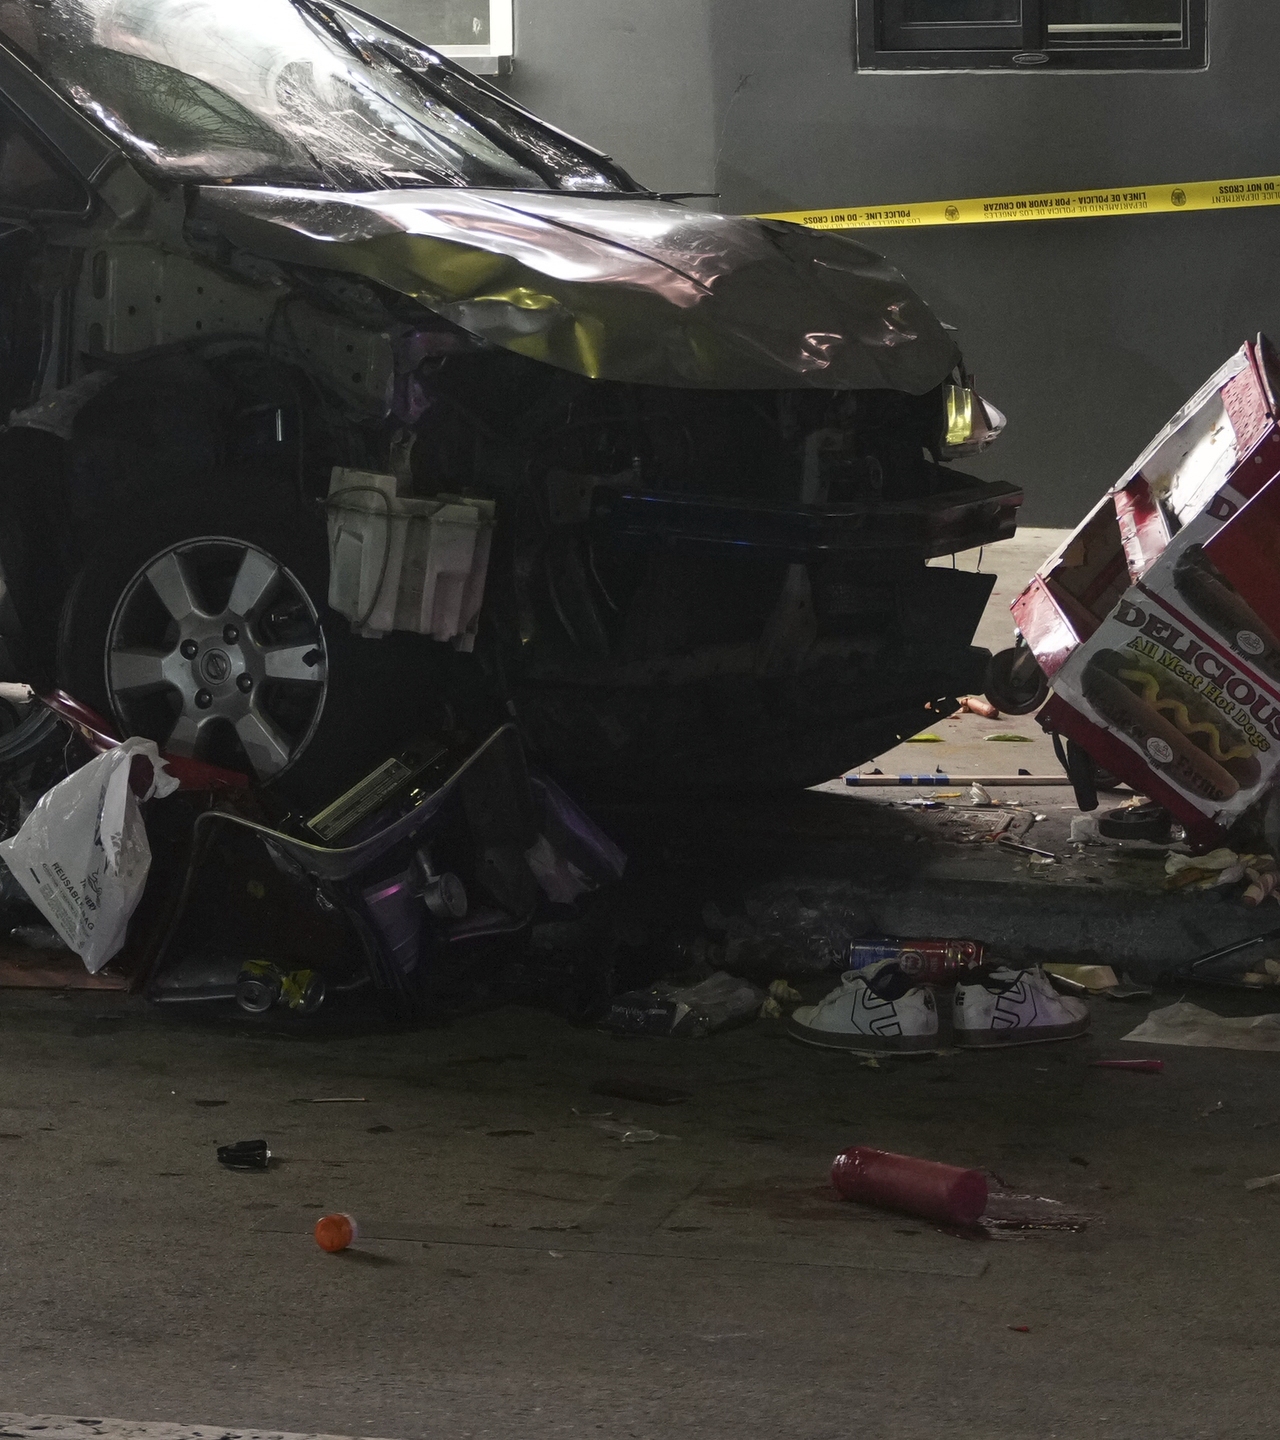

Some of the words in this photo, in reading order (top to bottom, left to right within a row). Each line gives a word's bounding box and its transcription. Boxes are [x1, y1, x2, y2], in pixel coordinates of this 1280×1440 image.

[1219, 185, 1244, 194] CROSS
[1246, 183, 1262, 192] NOT
[1264, 182, 1274, 191] DO
[1079, 195, 1109, 204] POLICIA
[1111, 194, 1121, 202] DE
[1123, 192, 1146, 201] LINEA
[1212, 192, 1260, 204] DEPARTMENT
[983, 201, 1014, 211] CRUZAR
[1016, 200, 1027, 209] NO
[1029, 199, 1053, 208] FAVOR
[1055, 198, 1070, 206] POR
[1090, 201, 1147, 212] DEPARTAMENTO
[1019, 208, 1034, 217] LOS
[1036, 208, 1045, 216] DE
[1046, 206, 1076, 215] POLICIA
[1078, 205, 1088, 213] DE
[830, 214, 845, 223] NOT
[847, 213, 857, 222] DO
[865, 211, 882, 220] LINE
[884, 210, 911, 219] POLICE
[983, 209, 1017, 219] ANGELES
[803, 215, 828, 225] CROSS
[1126, 636, 1159, 660] All
[1157, 651, 1203, 690] Meat
[1199, 680, 1236, 715] Hot
[1232, 707, 1271, 752] Dogs
[1176, 755, 1224, 799] Farms
